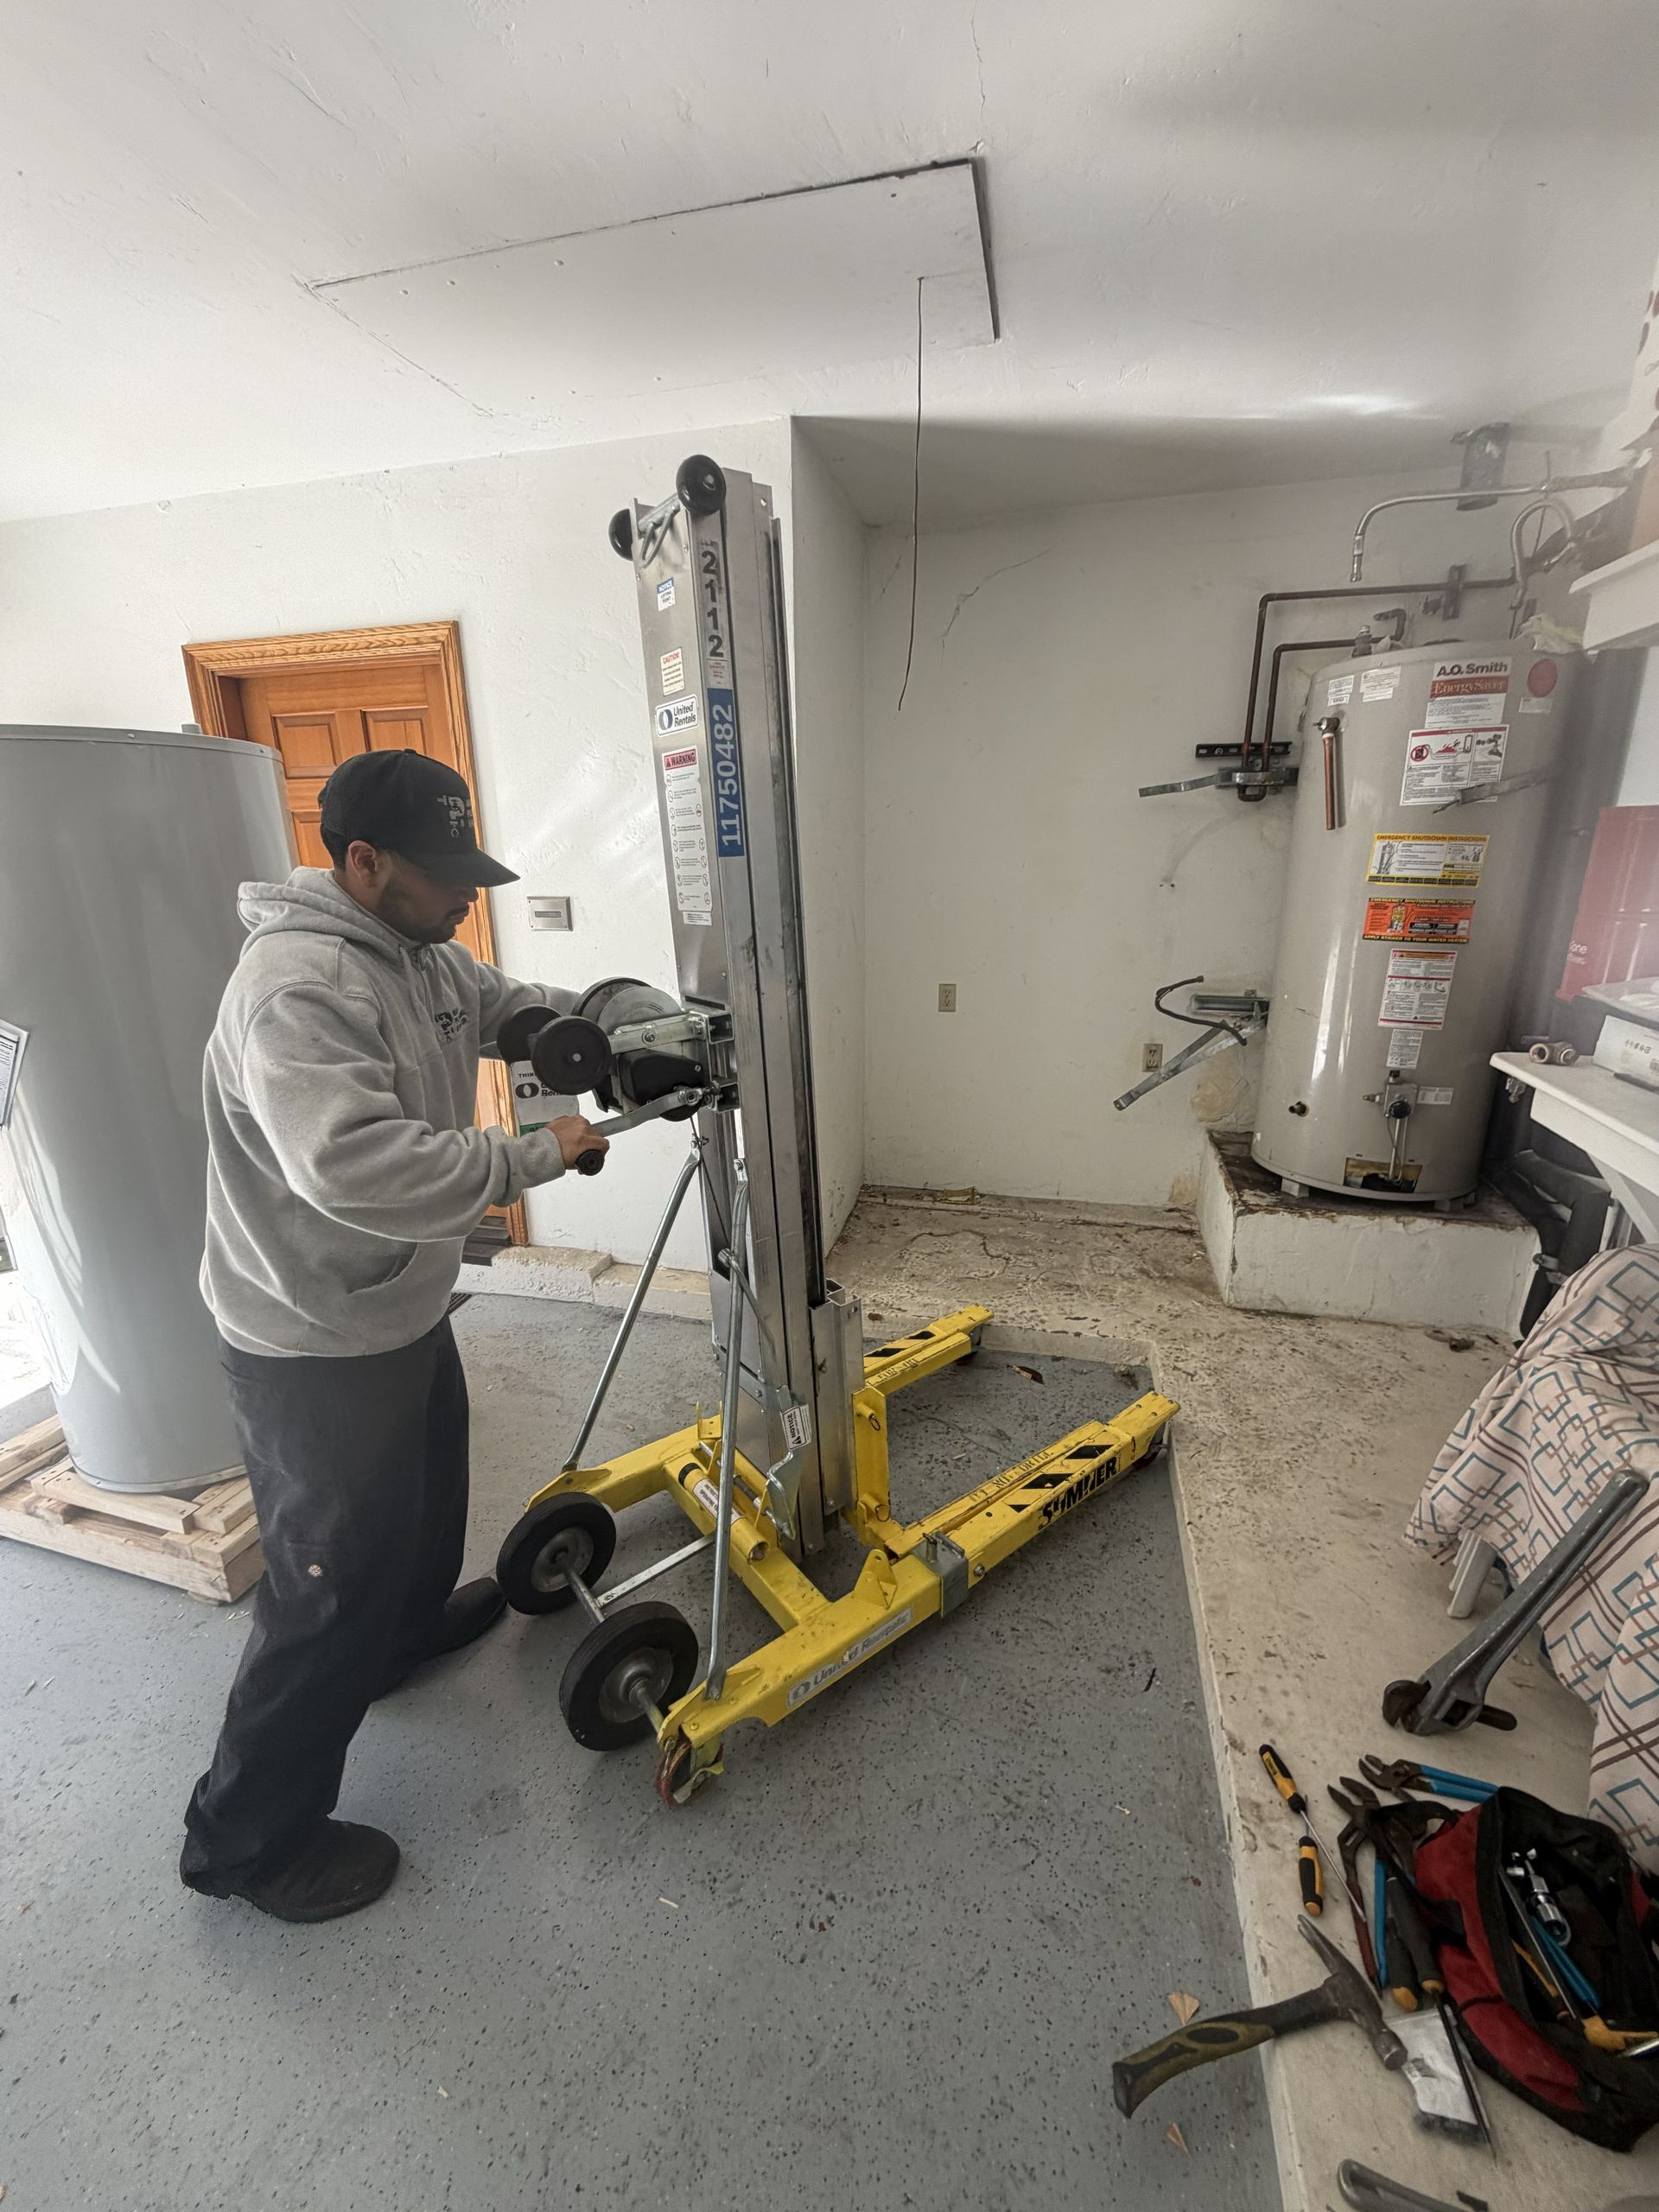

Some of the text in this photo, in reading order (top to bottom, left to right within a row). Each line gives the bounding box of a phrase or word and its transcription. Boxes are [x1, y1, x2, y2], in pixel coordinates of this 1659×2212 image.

[701, 550, 724, 658] 21112
[1465, 662, 1508, 674] Smith
[673, 701, 695, 716] United
[674, 713, 696, 728] Rentals
[671, 752, 696, 766] WARNING
[712, 704, 742, 846] 11750482
[787, 1413, 796, 1439] NOTICE
